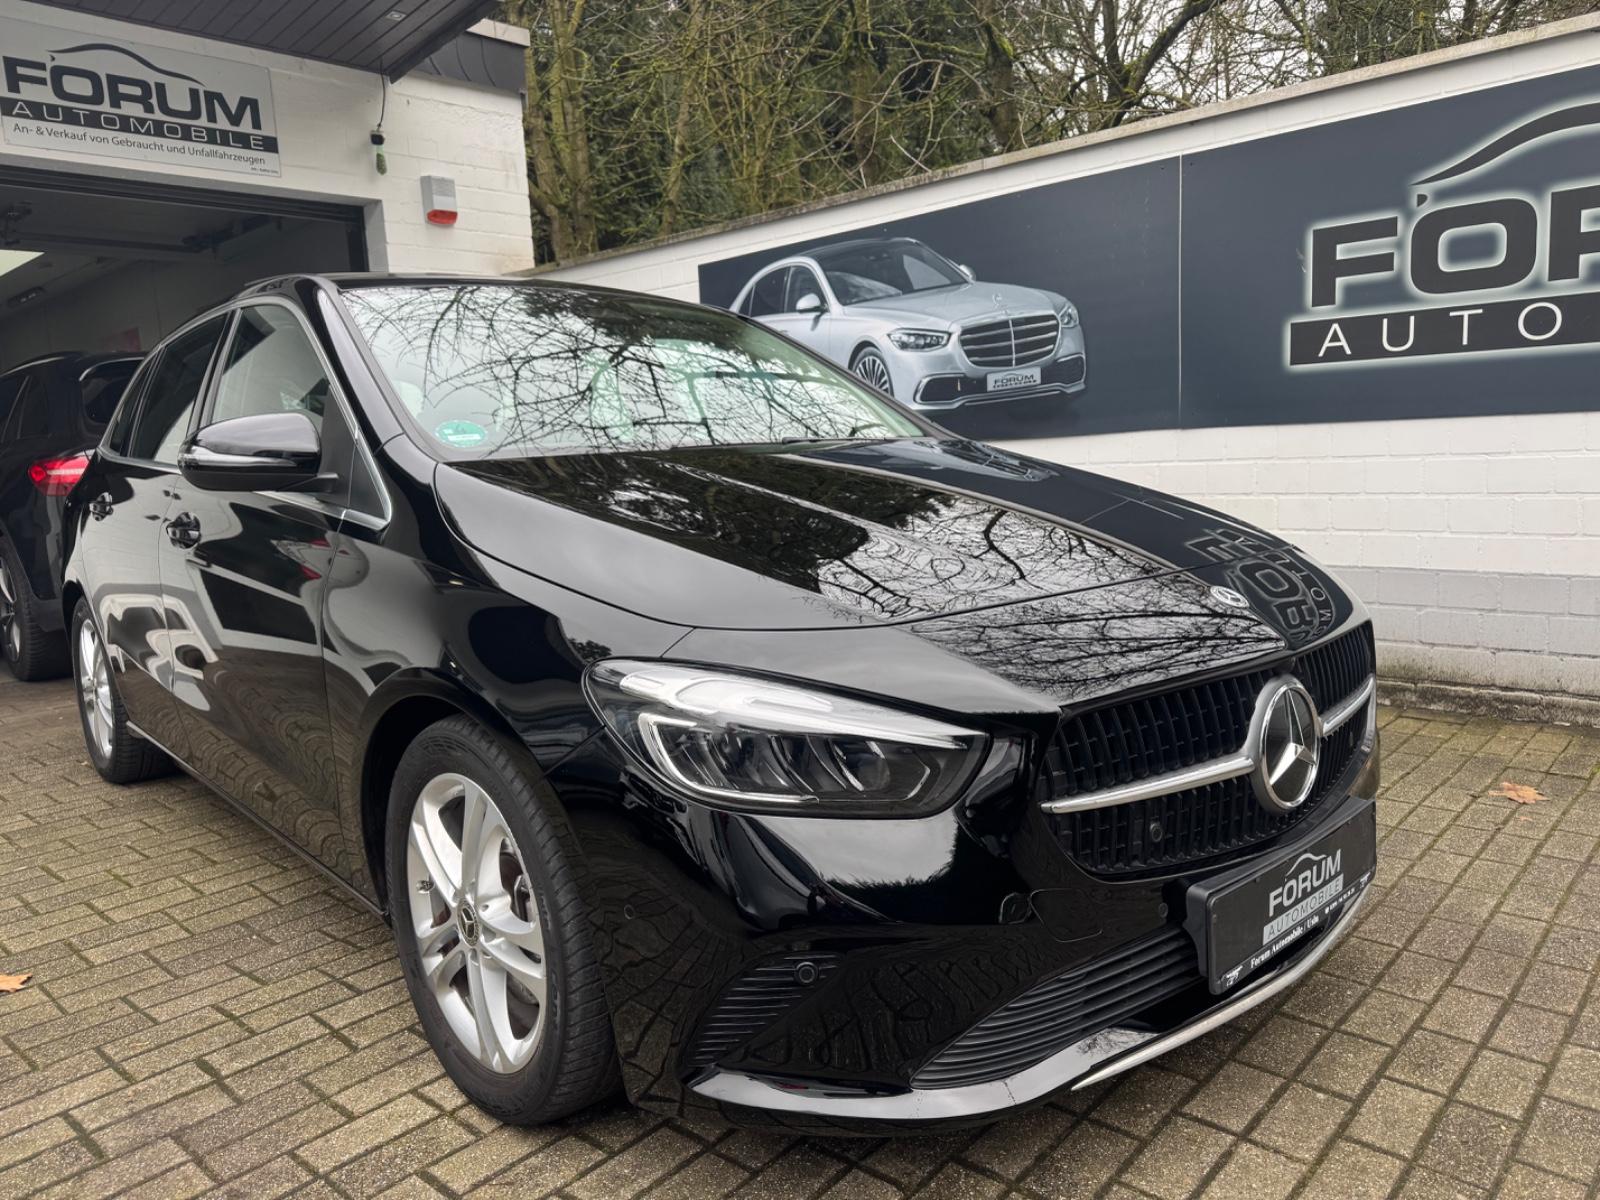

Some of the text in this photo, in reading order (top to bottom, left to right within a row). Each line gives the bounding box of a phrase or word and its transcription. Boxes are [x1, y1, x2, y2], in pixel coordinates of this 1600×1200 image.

[2, 55, 263, 131] FORUM
[12, 101, 265, 150] AUTOMOBILE
[13, 122, 266, 165] An- & Verkauf von Gebraucht und Unfallfahrzeugen
[1318, 302, 1562, 358] AUTO
[994, 374, 1035, 385] FORUM
[1267, 877, 1341, 940] AUTOMOBILE
[1269, 849, 1341, 917] FORUM
[1250, 951, 1271, 968] Forum
